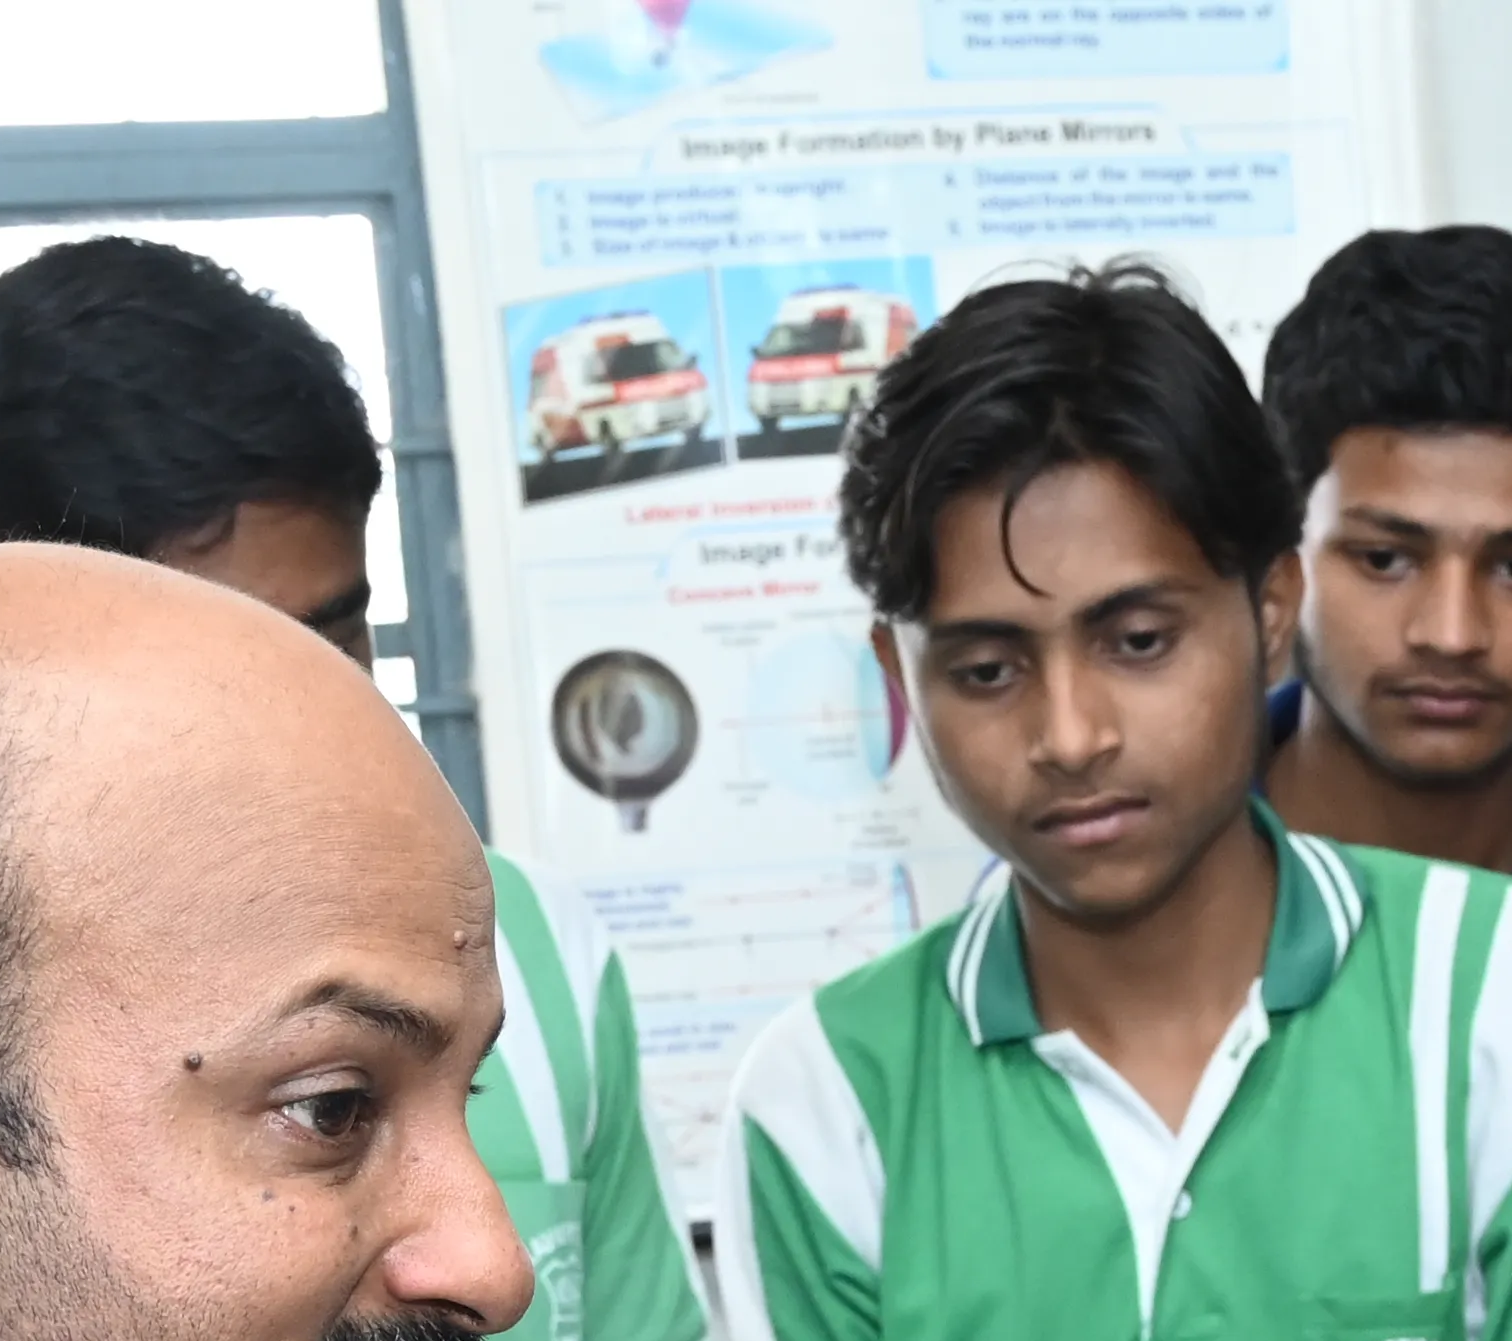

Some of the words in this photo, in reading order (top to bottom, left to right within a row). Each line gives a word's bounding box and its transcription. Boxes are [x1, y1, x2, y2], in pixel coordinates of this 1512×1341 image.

[681, 135, 769, 162] Image
[777, 127, 925, 153] Formation
[931, 124, 968, 154] by
[974, 119, 1052, 147] Plane
[1059, 117, 1158, 145] Mirrors
[700, 541, 786, 568] Image
